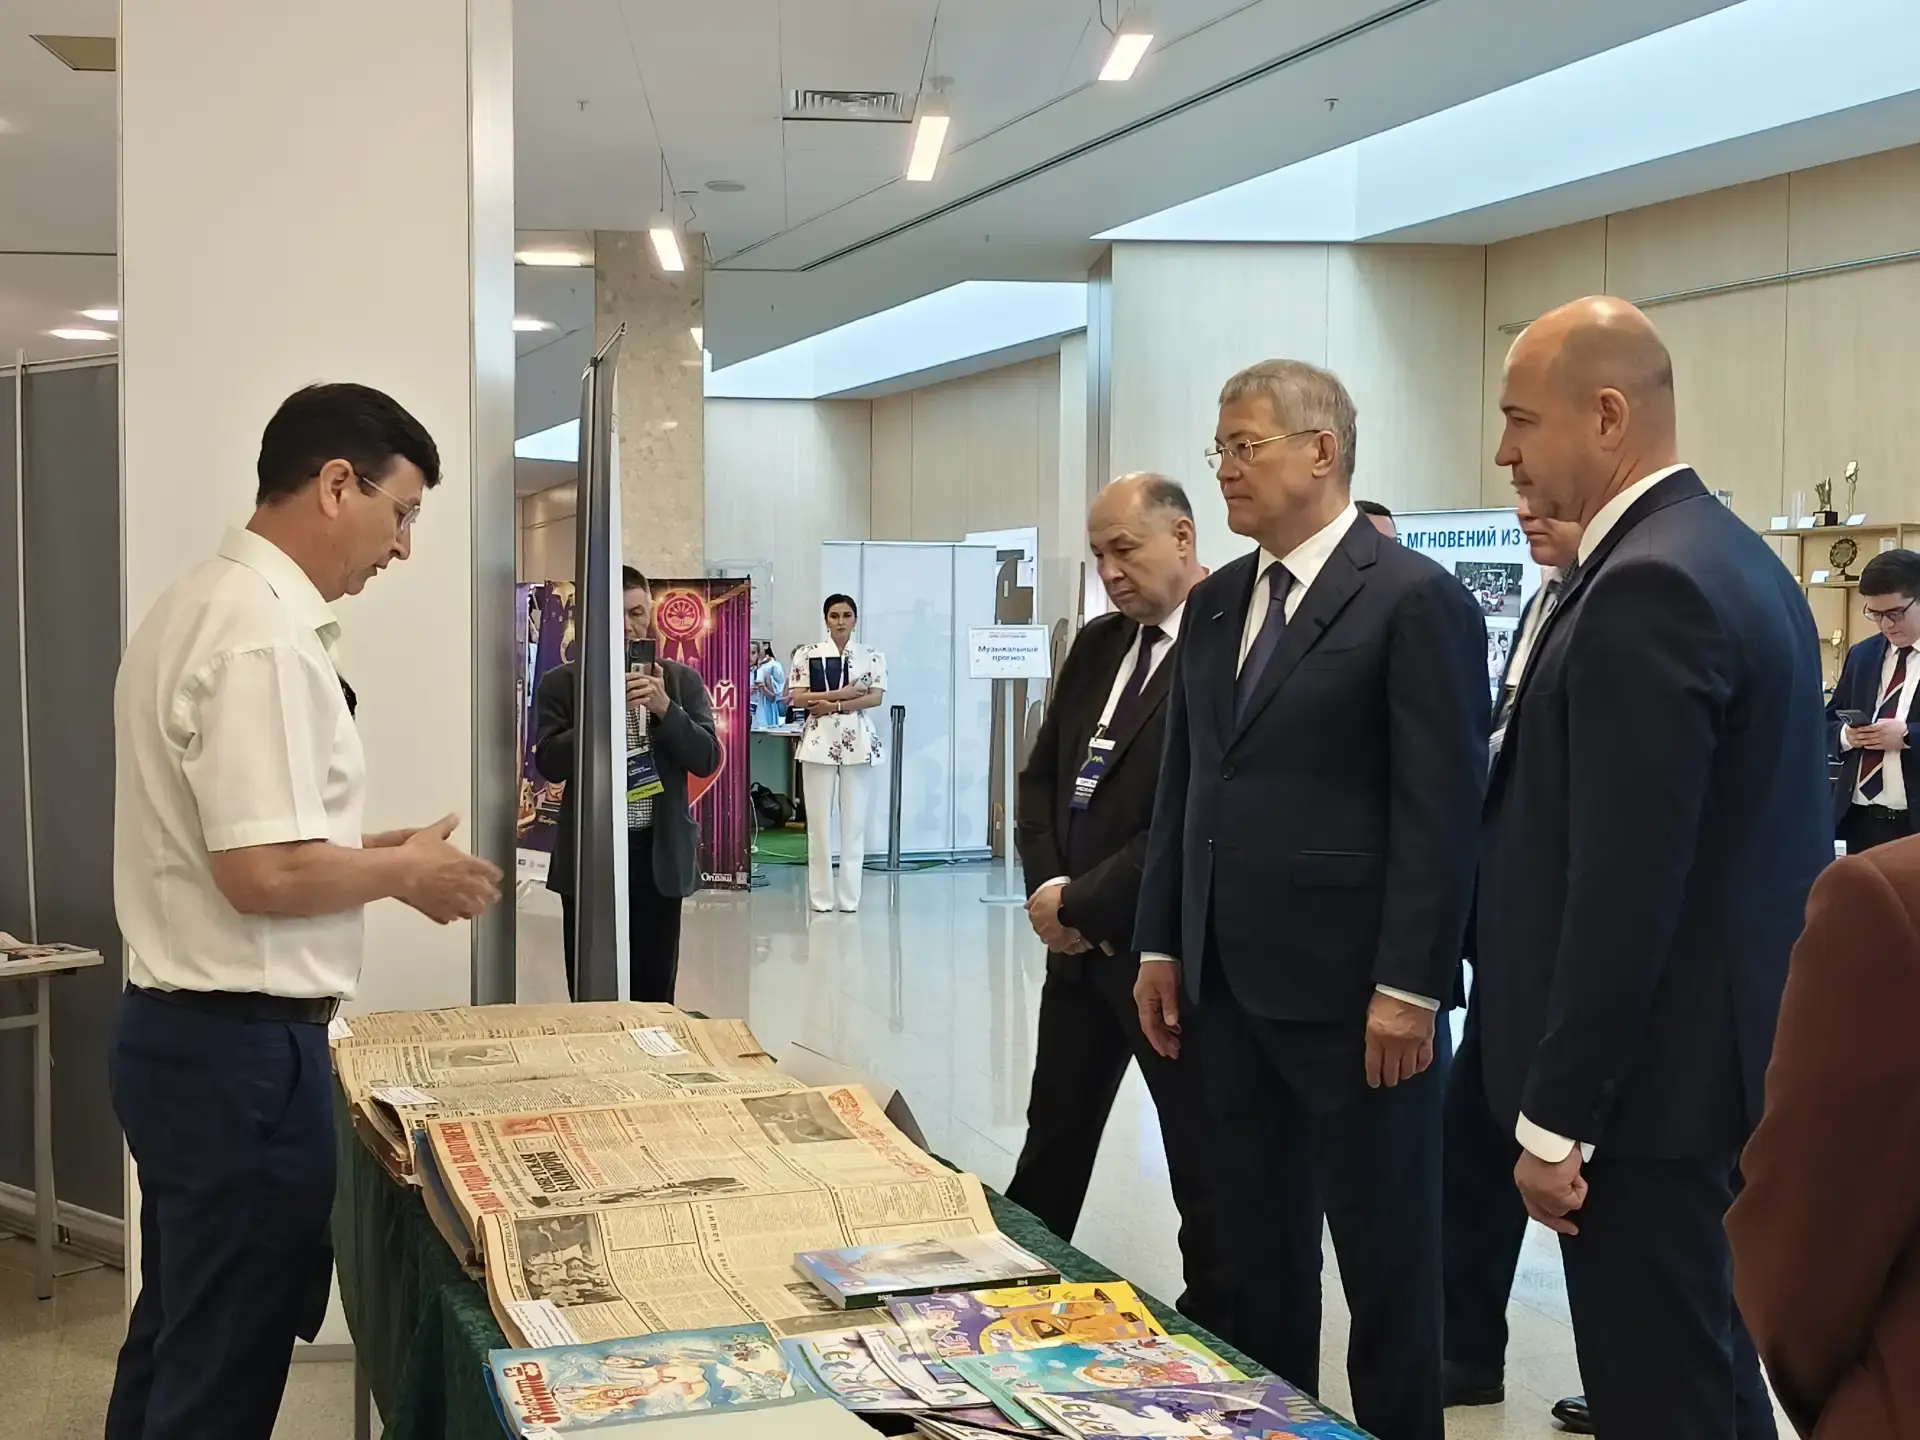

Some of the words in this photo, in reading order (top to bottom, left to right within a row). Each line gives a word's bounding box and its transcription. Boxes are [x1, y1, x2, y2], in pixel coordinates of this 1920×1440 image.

[1407, 526, 1496, 549] МГНОВЕНИЙ
[1501, 528, 1521, 547] ИЗ
[977, 645, 1039, 654] Музыкальный
[520, 1153, 559, 1194] СОВЕТСКАЯ
